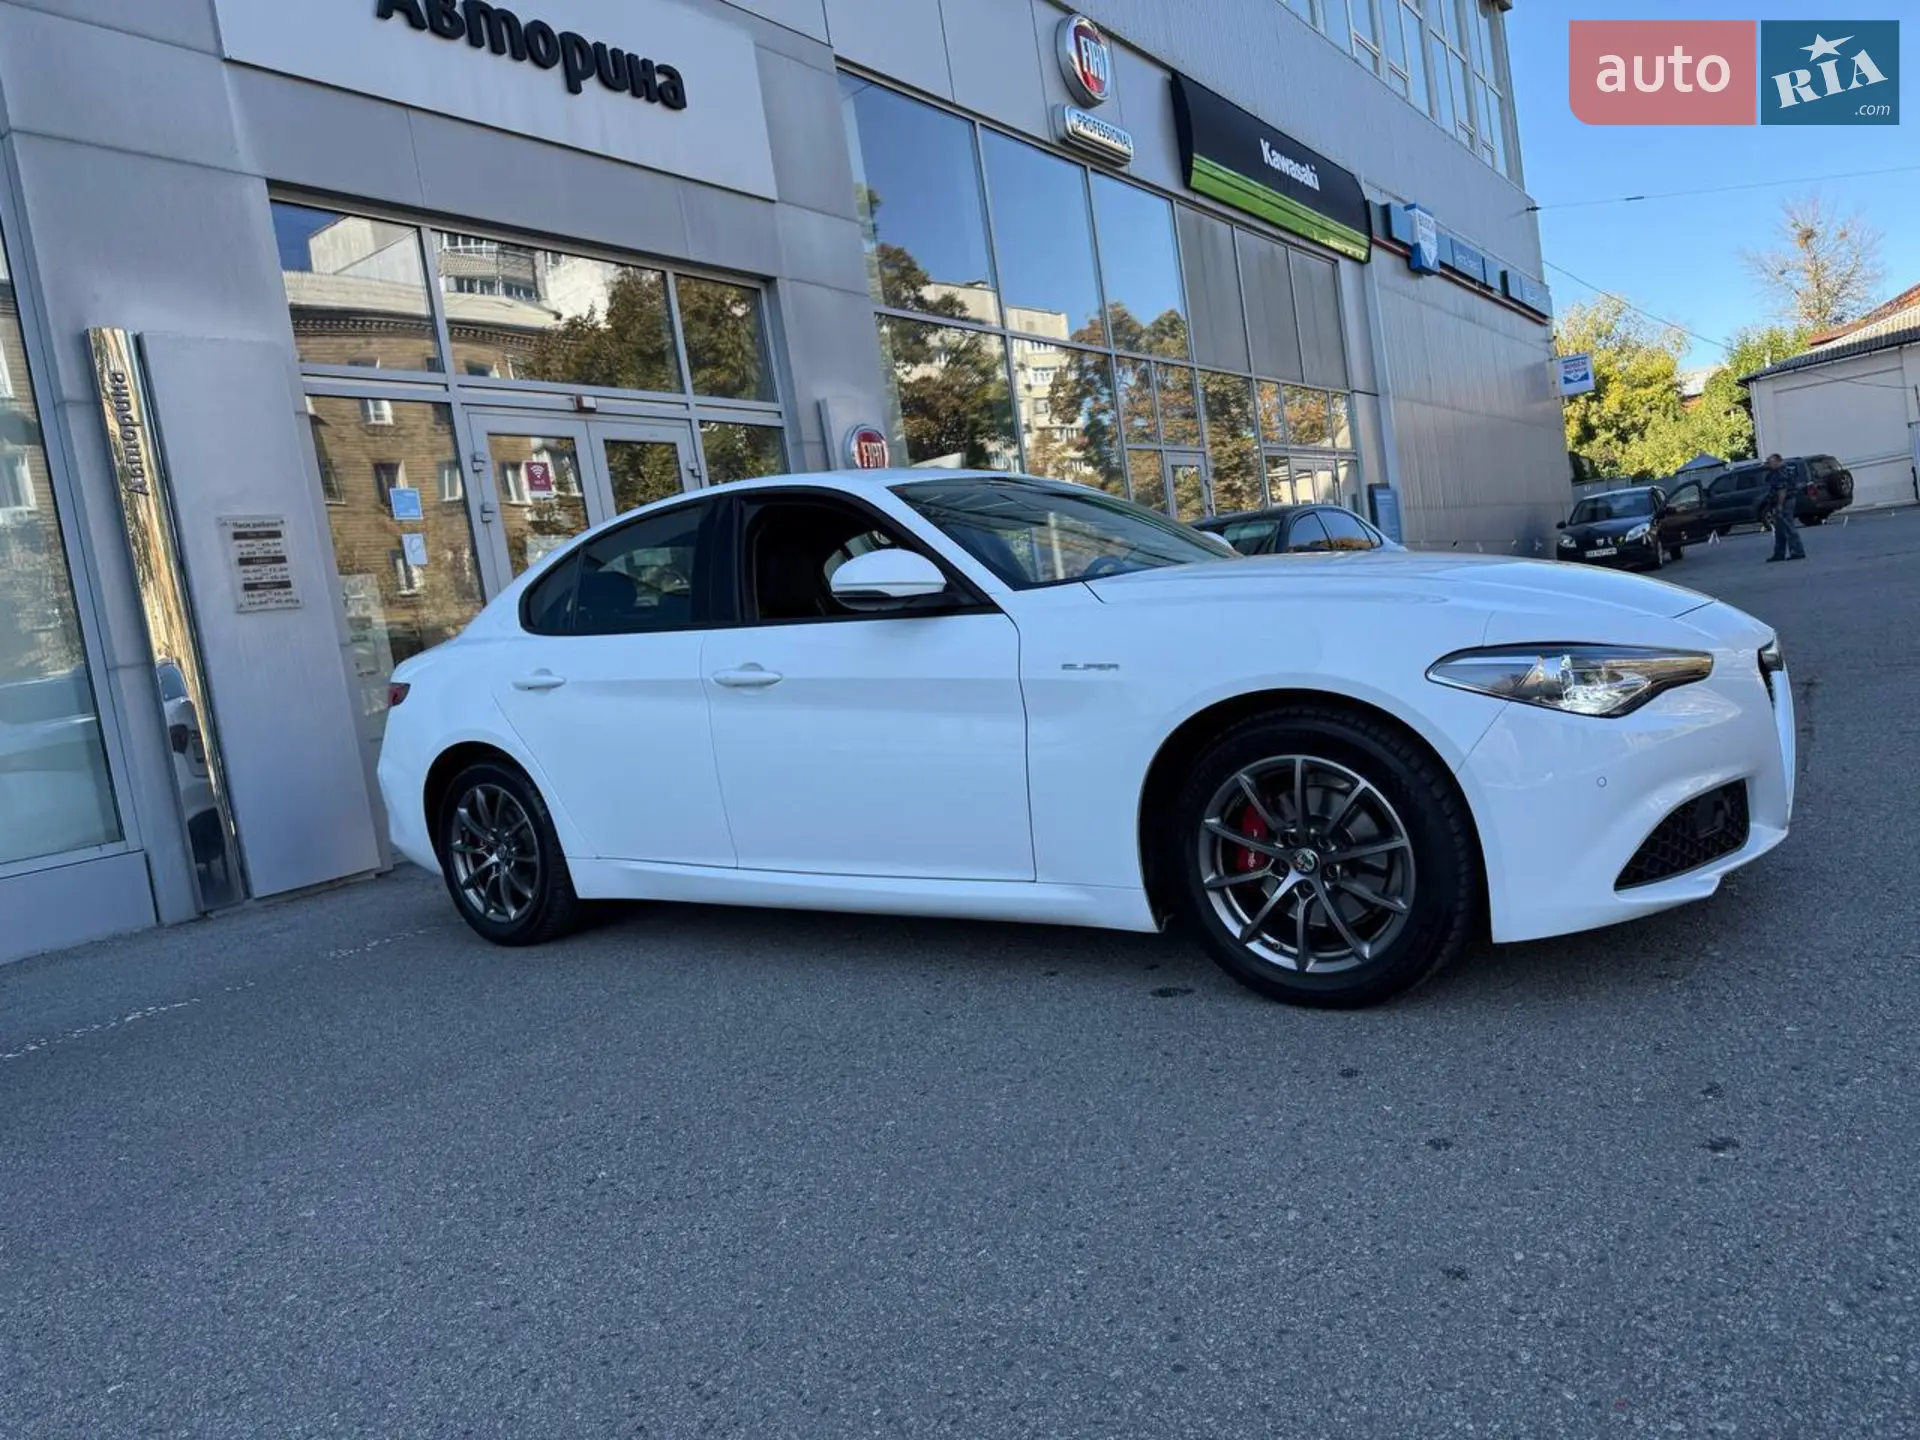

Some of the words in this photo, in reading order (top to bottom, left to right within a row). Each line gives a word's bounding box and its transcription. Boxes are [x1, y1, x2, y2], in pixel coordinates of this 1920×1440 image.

[1080, 35, 1107, 82] FIAT
[1075, 112, 1132, 149] PROFESSIONAL
[1260, 138, 1320, 191] Kawasaki
[109, 371, 149, 496] Авторина
[860, 440, 886, 469] FIAT
